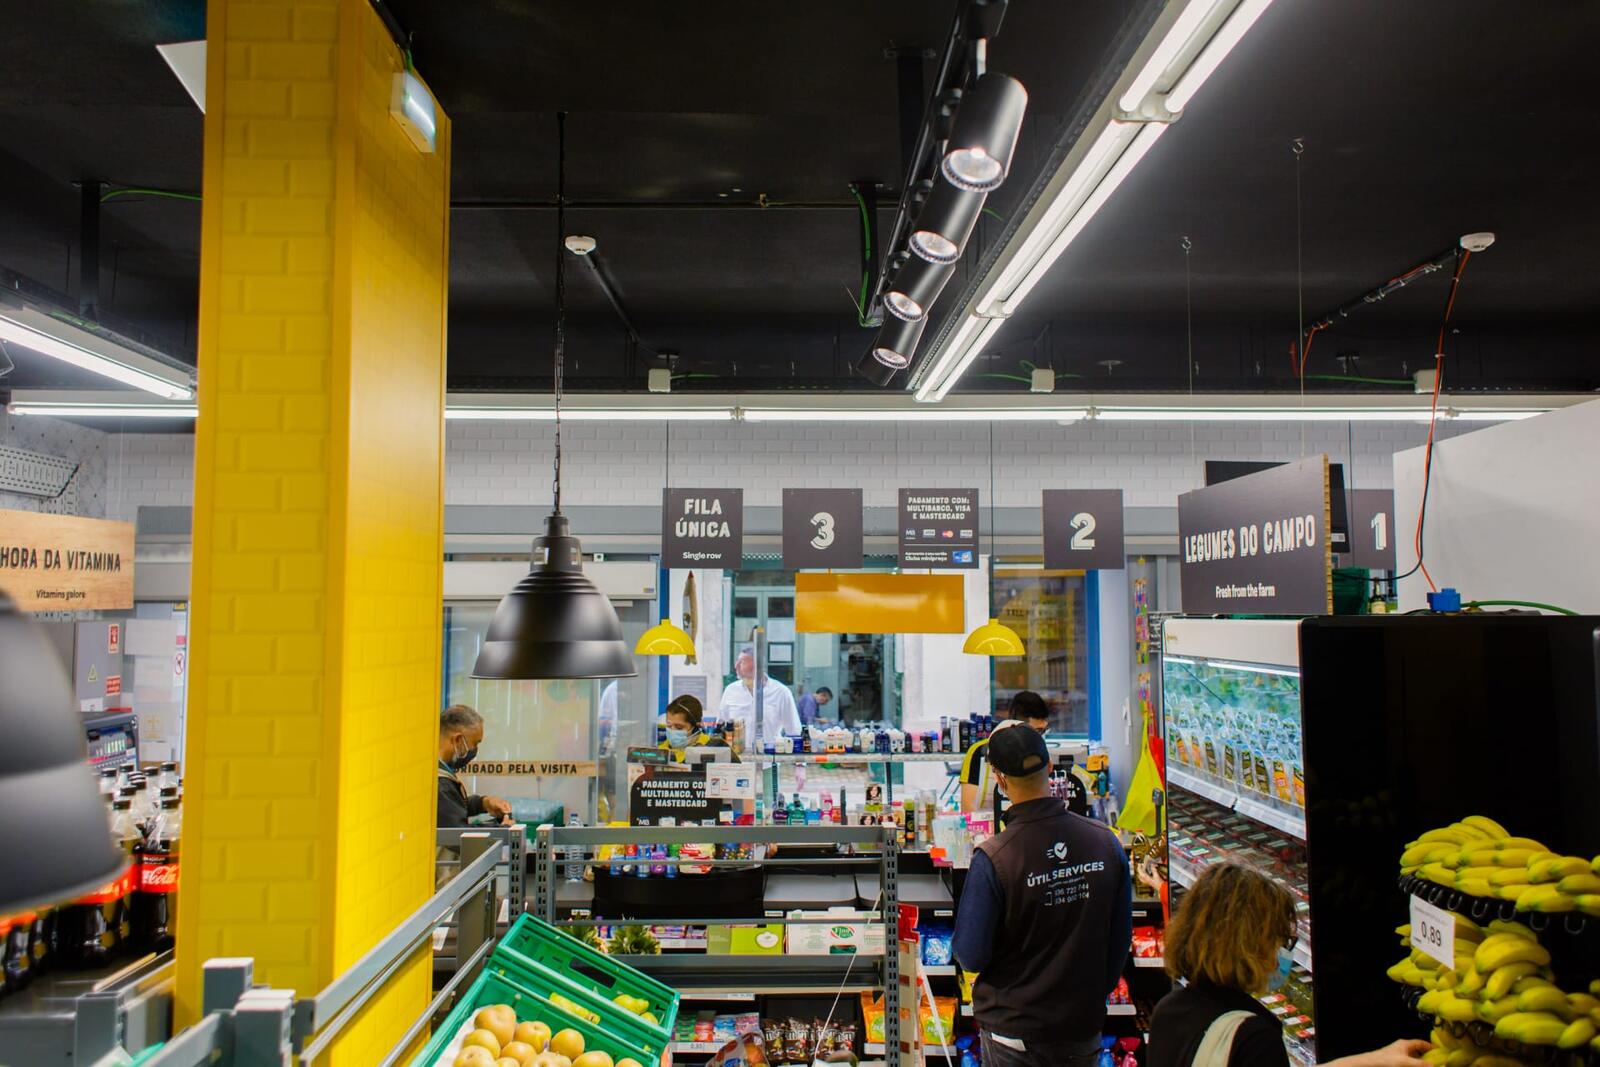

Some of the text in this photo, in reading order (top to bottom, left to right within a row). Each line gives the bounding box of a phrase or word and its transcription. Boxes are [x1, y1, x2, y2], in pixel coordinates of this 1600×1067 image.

[684, 498, 722, 515] FILA
[908, 496, 949, 504] PAGAMENTO
[912, 512, 965, 520] E MASTERCARD
[675, 517, 731, 538] ÚNICA
[810, 511, 836, 550] 3
[1070, 512, 1096, 550] 2
[1371, 512, 1387, 551] 1
[1185, 514, 1316, 564] LEGUMES DO CAMPO
[0, 546, 121, 573] HORA DA VITAMINA
[682, 551, 706, 561] Single
[36, 589, 86, 601] Vitamins galore
[1215, 582, 1276, 598] Fresh from the farm
[508, 764, 535, 774] PELA
[541, 764, 577, 774] VISITA
[642, 780, 689, 789] PAGAMENTO
[640, 790, 693, 798] MULTIBANCO,
[1027, 872, 1051, 887] ÚTIL
[1052, 861, 1105, 880] SERVICES
